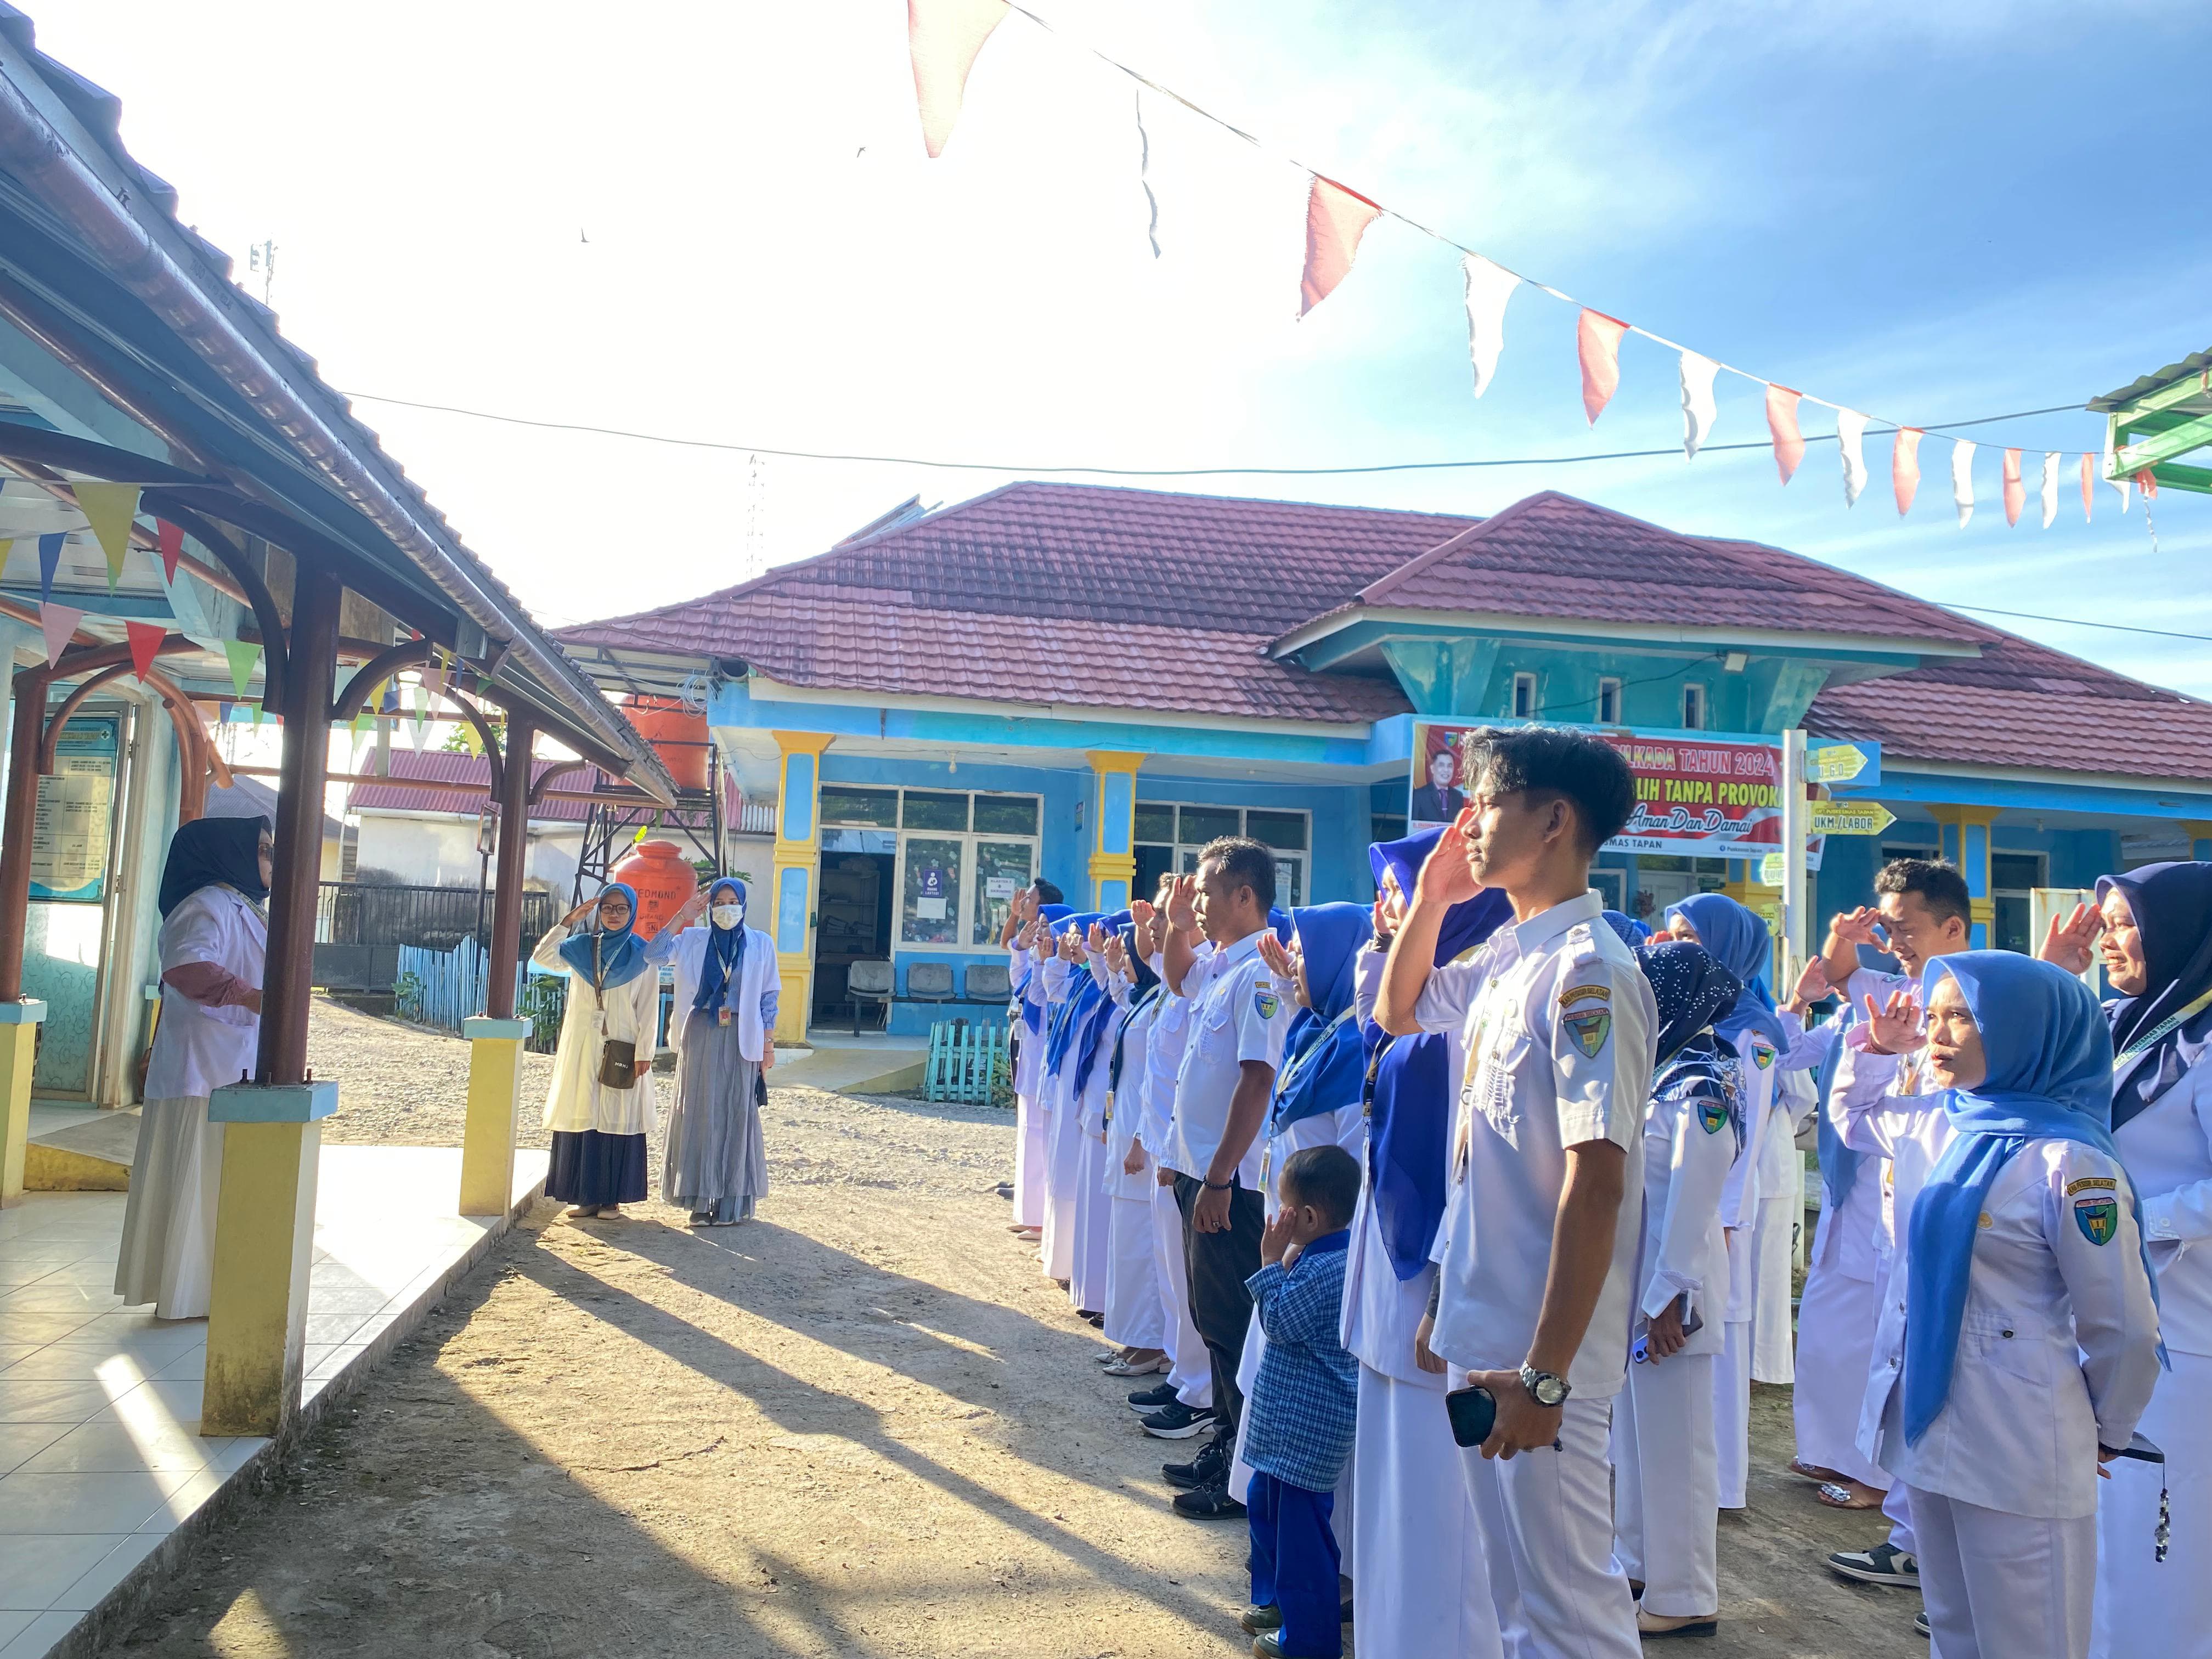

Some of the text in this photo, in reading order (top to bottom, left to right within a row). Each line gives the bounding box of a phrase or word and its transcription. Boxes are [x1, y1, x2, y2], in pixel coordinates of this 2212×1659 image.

[1680, 748, 1731, 775] TAHUN
[1734, 752, 1774, 776] 2024
[1666, 779, 1713, 804] TANPA
[1628, 804, 1753, 833] Aman Dan Damai
[1632, 839, 1663, 849] TAPAN
[2124, 1030, 2158, 1056] PUSKESMAS
[2155, 1015, 2176, 1032] TAPAN
